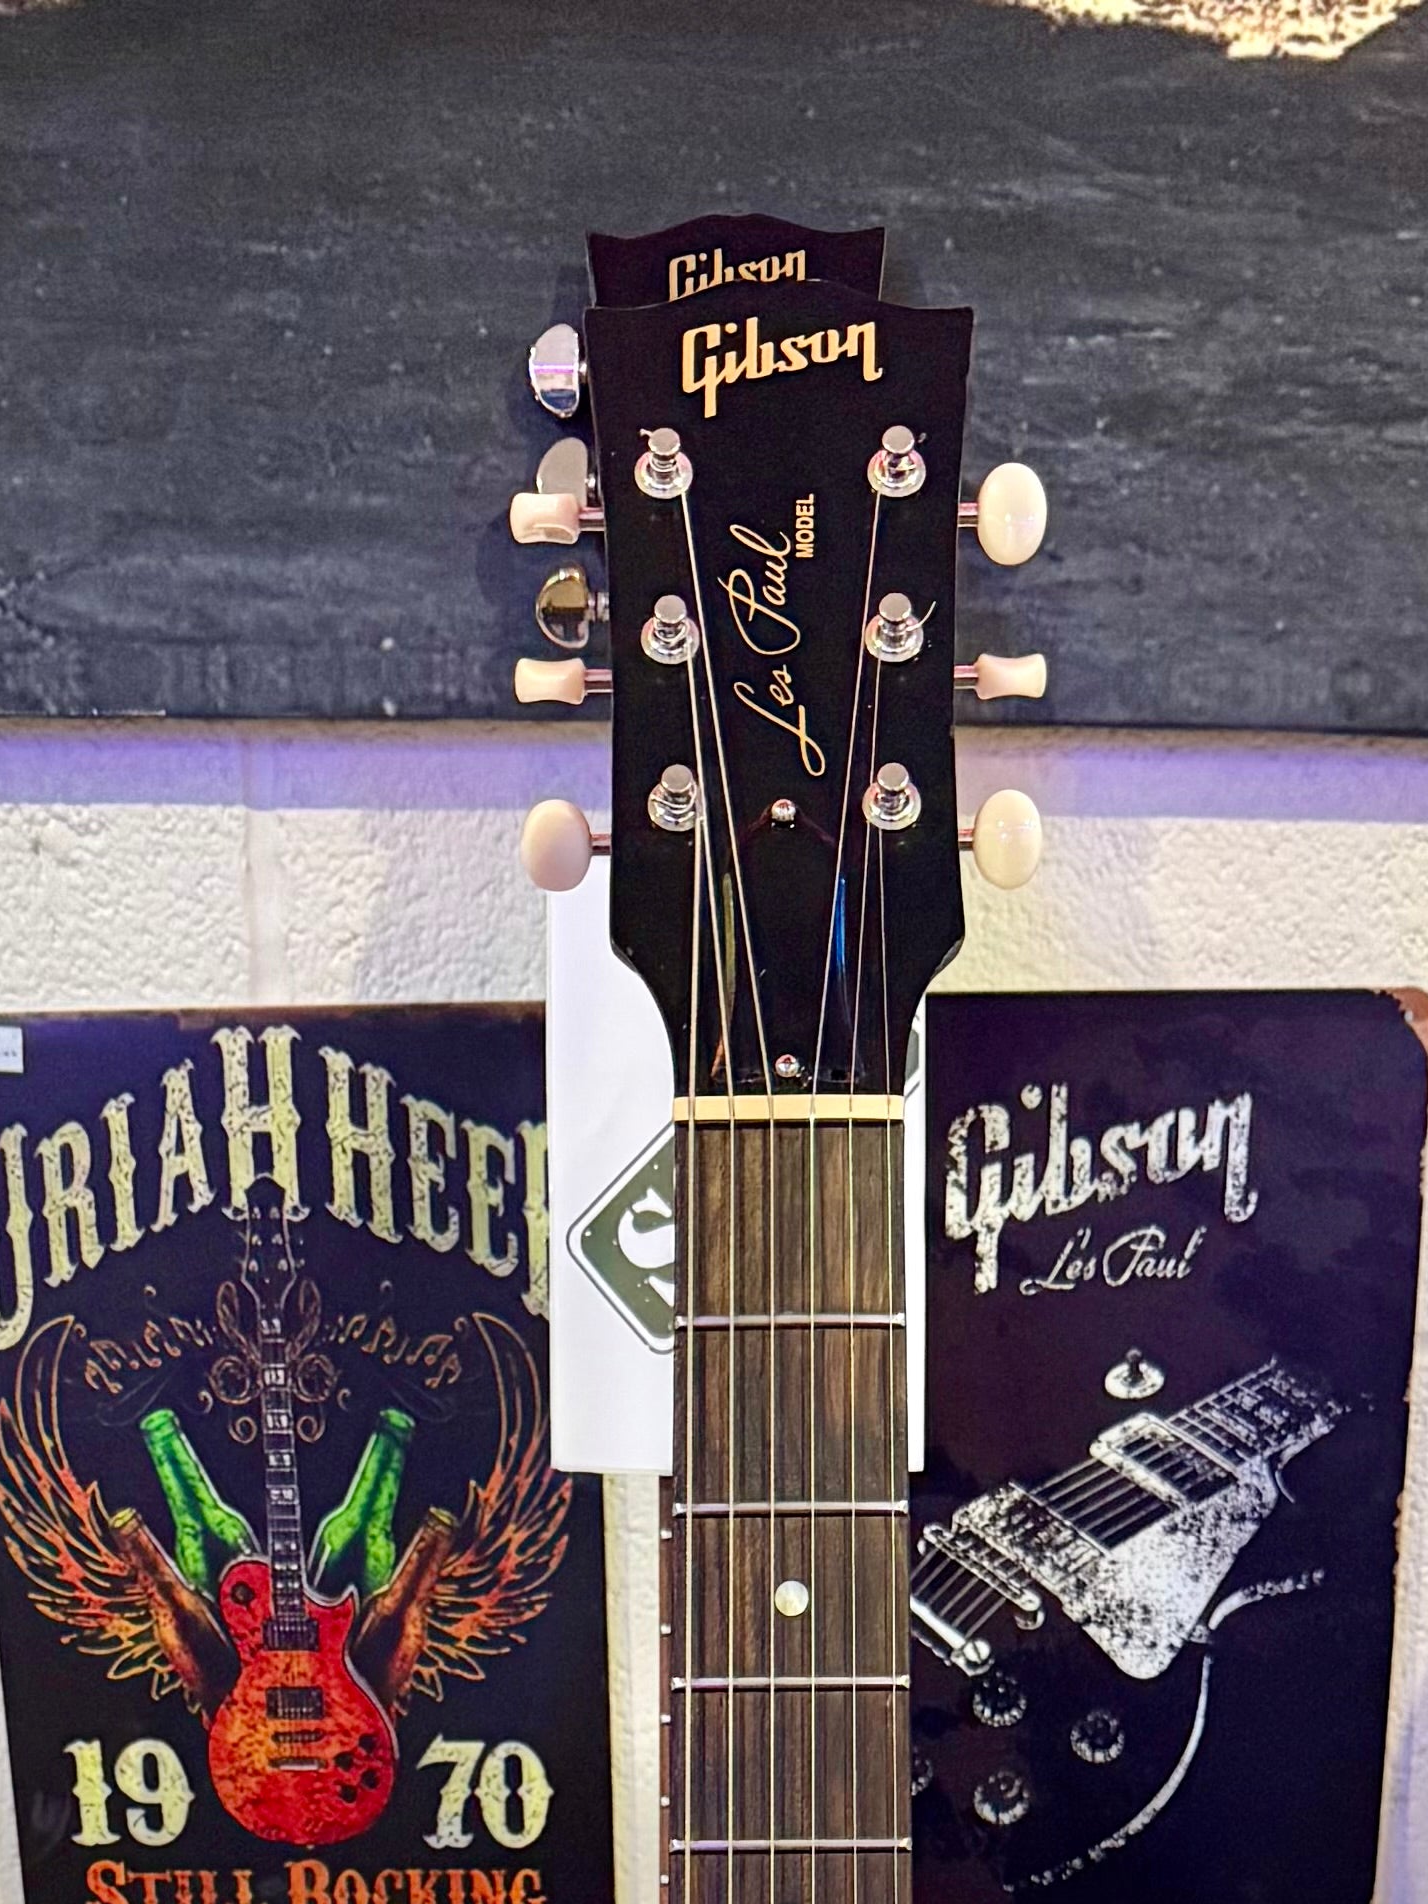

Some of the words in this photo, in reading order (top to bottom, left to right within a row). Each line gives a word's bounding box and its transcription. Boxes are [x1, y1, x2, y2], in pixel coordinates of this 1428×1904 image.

[668, 247, 808, 301] Gibson
[682, 316, 884, 417] Gibson
[797, 493, 816, 559] MODEL
[718, 524, 802, 655] Paul
[734, 665, 827, 777] Les
[944, 1081, 1258, 1295] Gibson
[1019, 1226, 1096, 1296] Les
[1103, 1225, 1208, 1288] Paul
[64, 1737, 196, 1848] 19
[416, 1733, 554, 1849] 70
